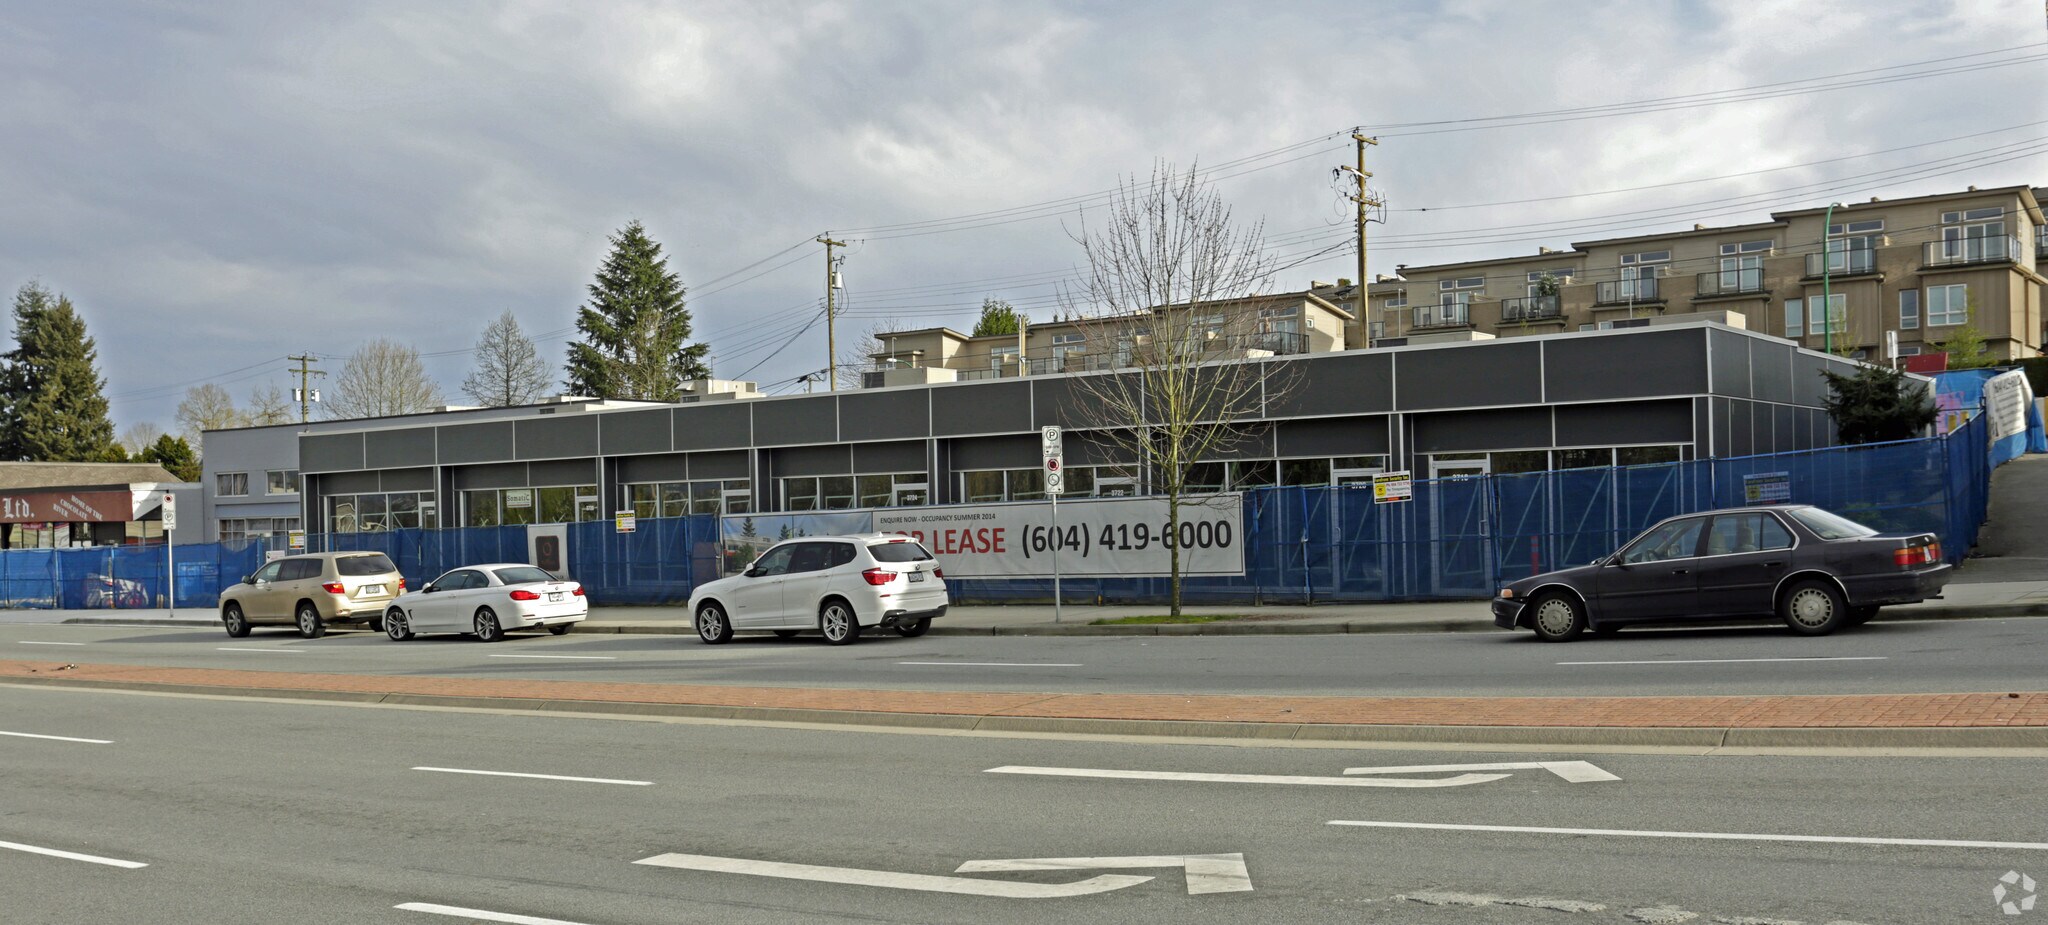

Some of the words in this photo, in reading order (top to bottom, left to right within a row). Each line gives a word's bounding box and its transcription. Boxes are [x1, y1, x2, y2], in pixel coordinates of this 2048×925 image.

[2, 497, 35, 519] Ltd.
[53, 503, 69, 517] RIVER
[60, 499, 87, 520] CHOCOLATE
[71, 495, 86, 509] HOME
[880, 516, 903, 524] ENQUIRE
[921, 513, 953, 523] OCCUPANCY
[953, 513, 981, 521] SUMMER
[981, 512, 996, 520] 2014
[933, 527, 1006, 555] LEASE
[1022, 522, 1090, 558] (604)
[1099, 520, 1232, 551] 419-6000
